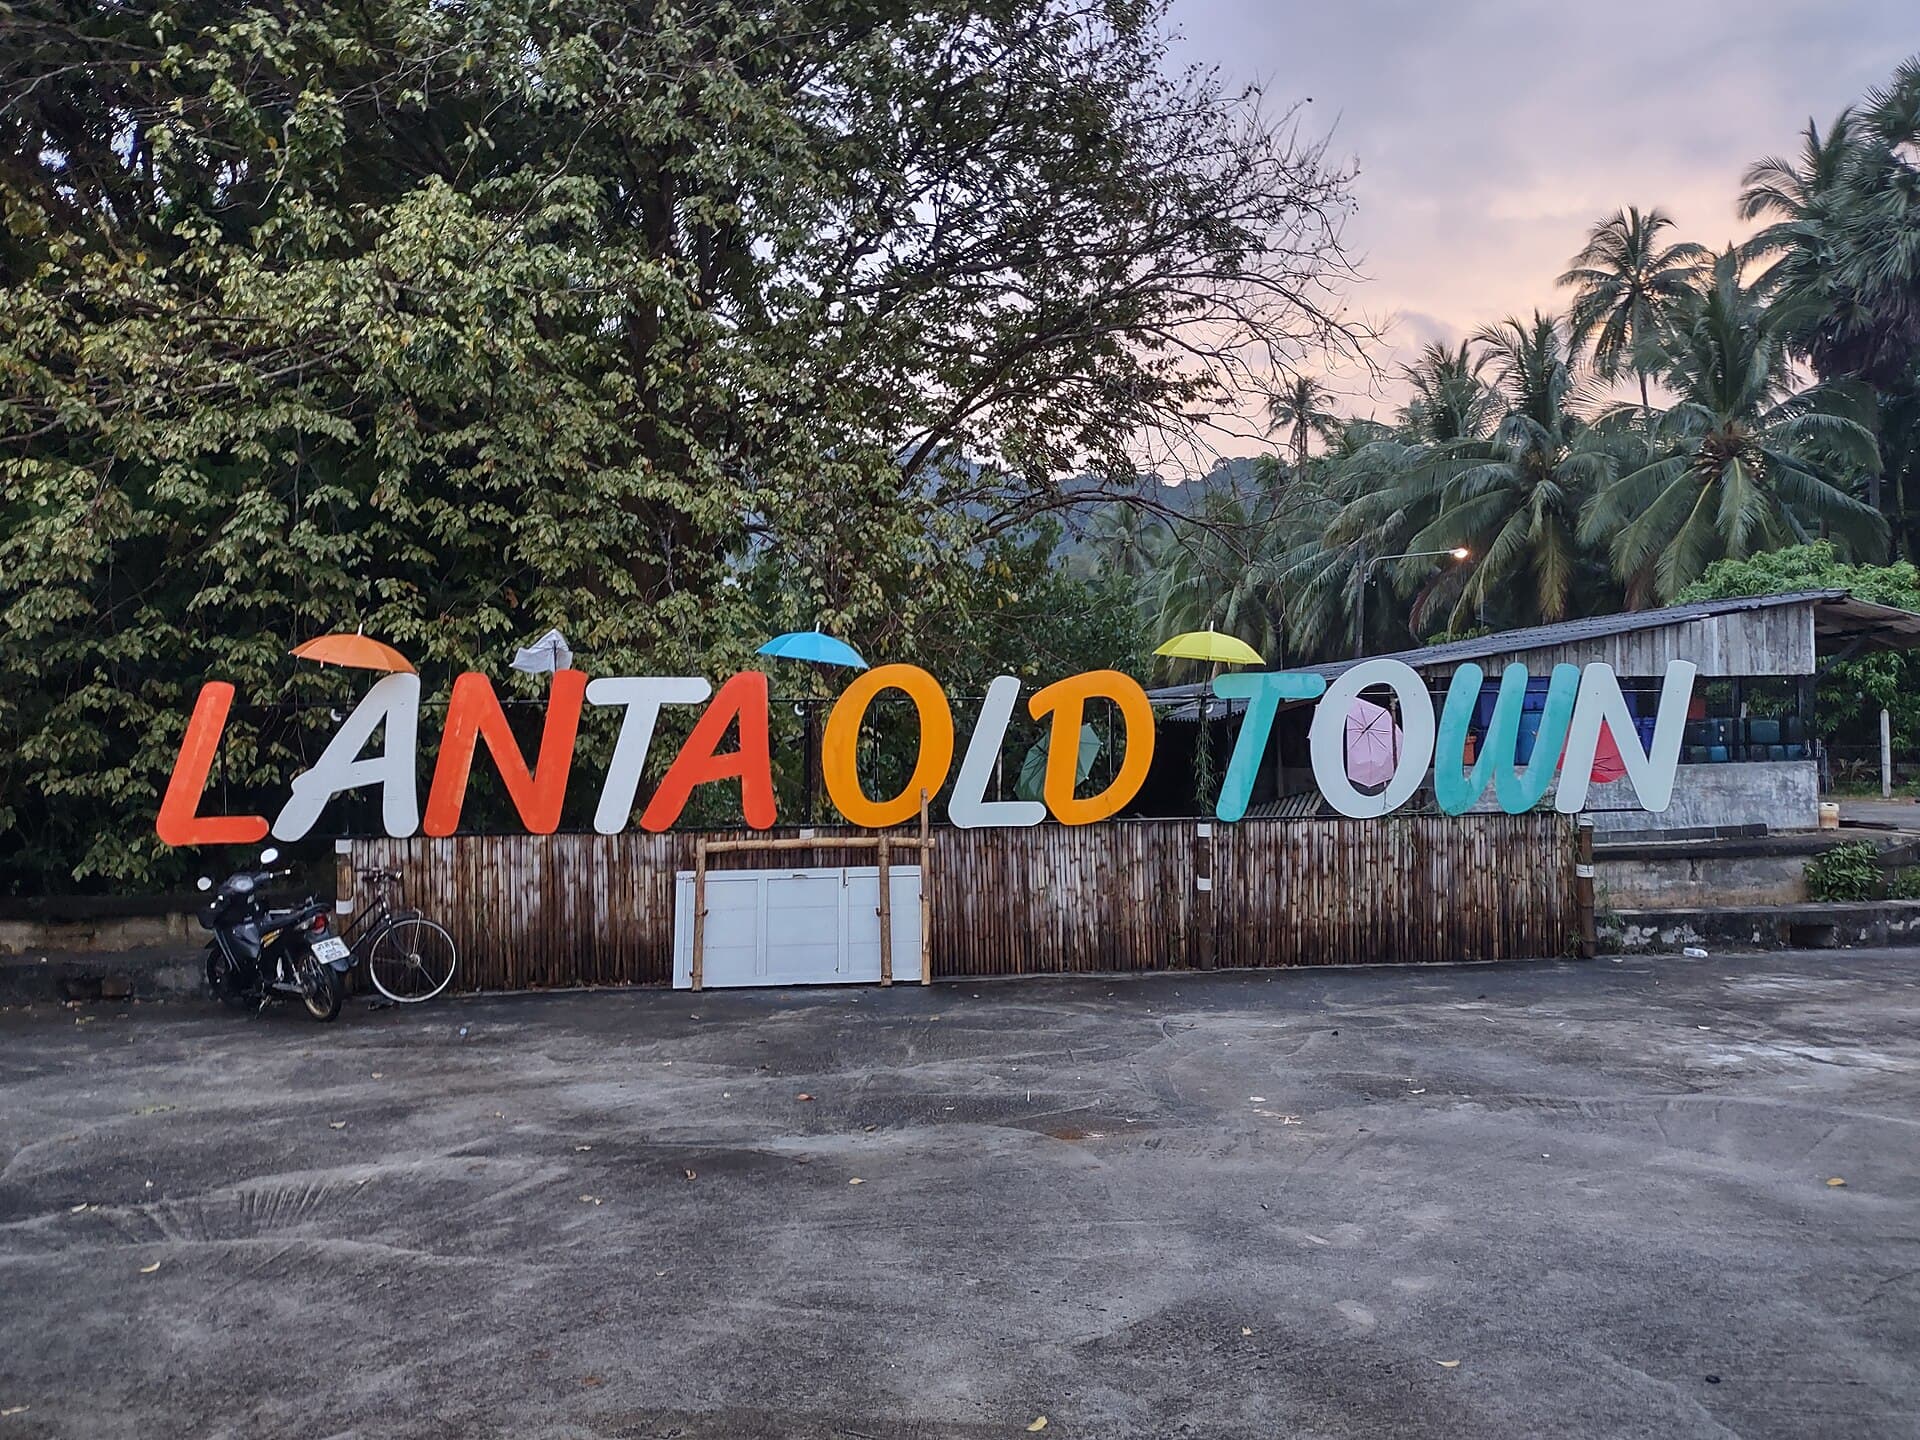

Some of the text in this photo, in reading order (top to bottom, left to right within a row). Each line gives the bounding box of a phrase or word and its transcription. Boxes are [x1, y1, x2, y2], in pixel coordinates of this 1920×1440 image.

[156, 659, 1697, 846] LANTA OLD TOWN
